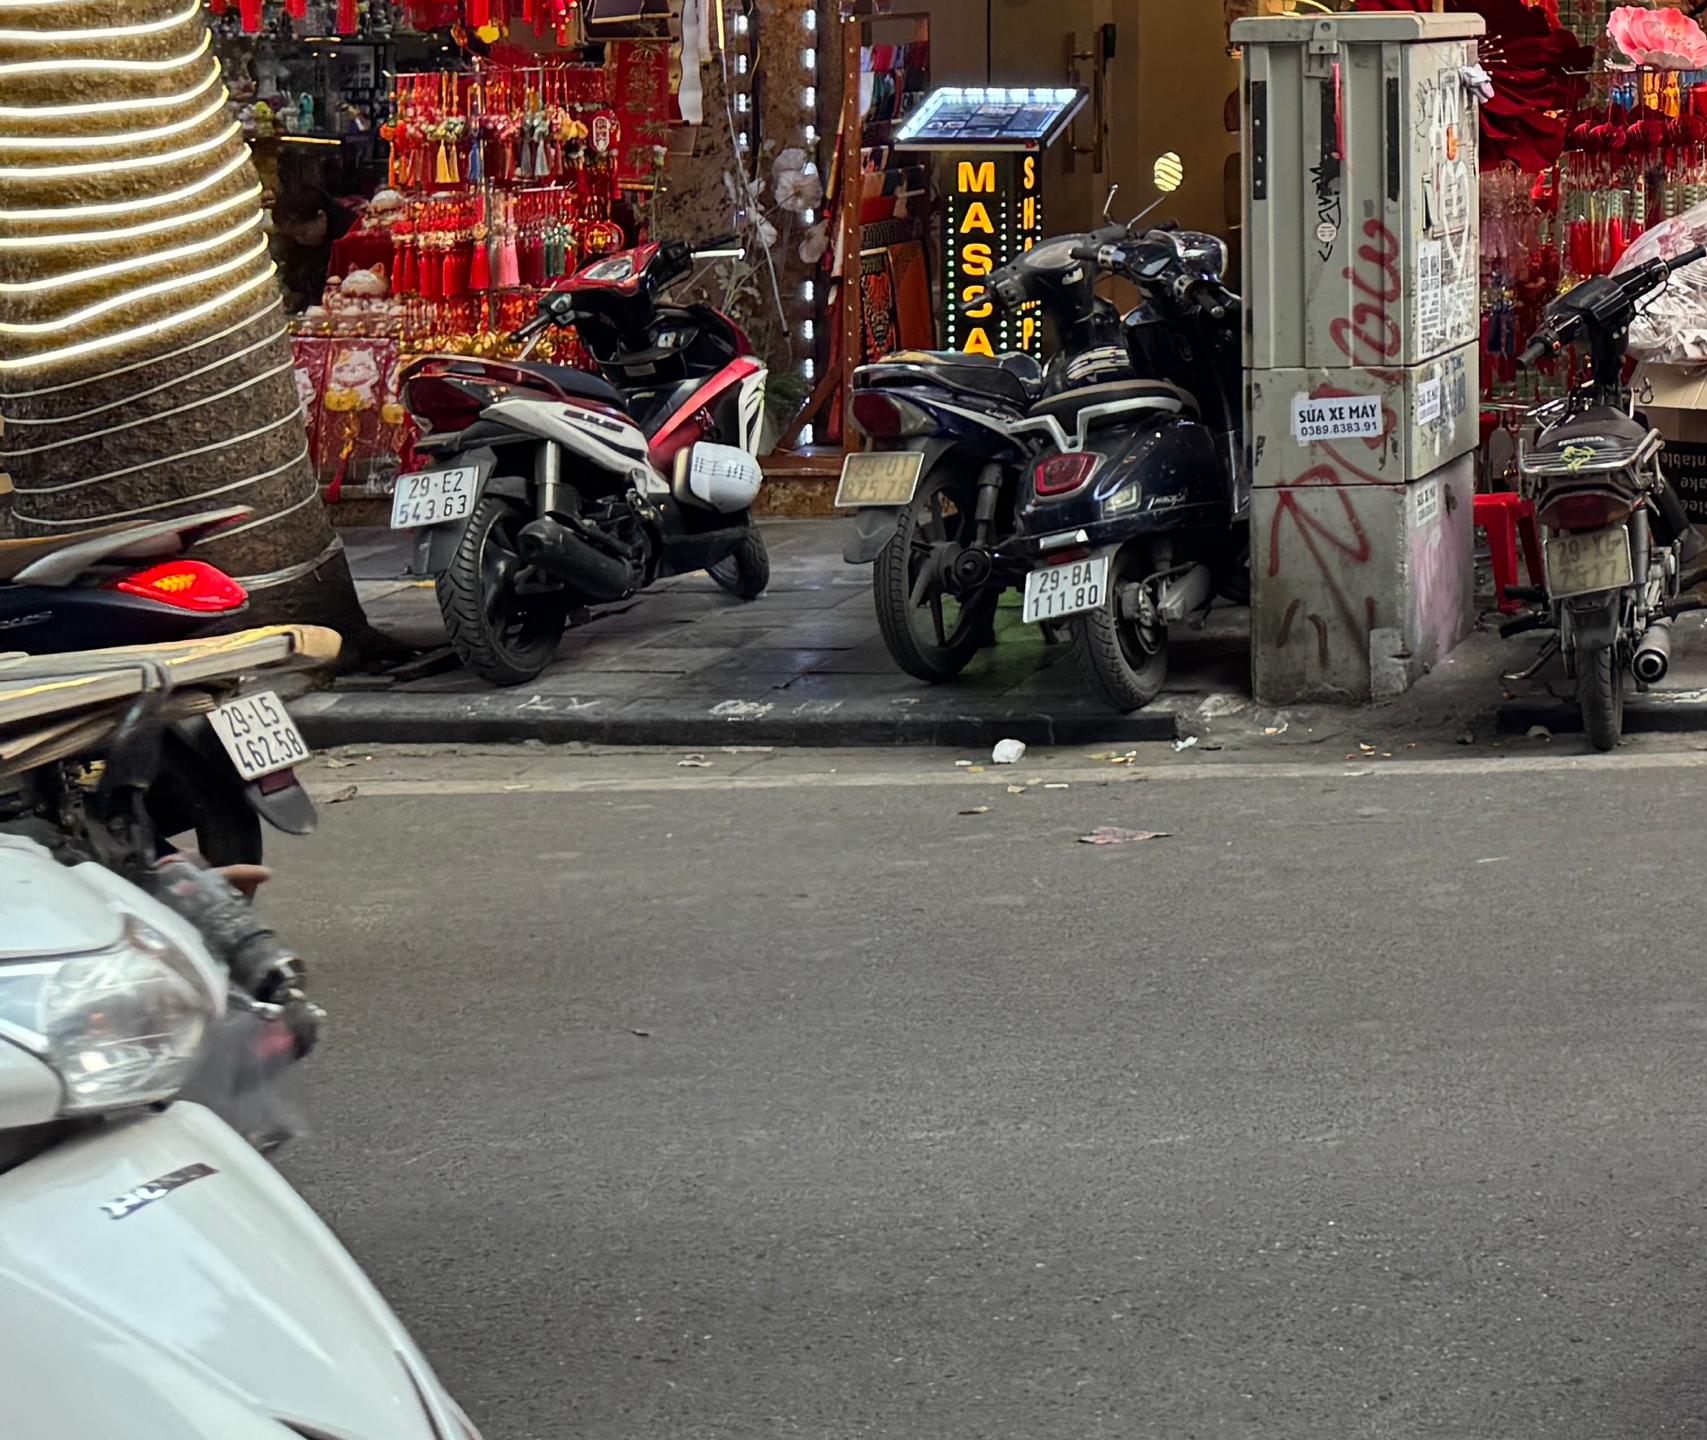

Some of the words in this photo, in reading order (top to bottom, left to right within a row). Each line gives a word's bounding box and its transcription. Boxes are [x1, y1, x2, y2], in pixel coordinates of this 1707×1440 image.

[1299, 403, 1326, 423] SỬA
[1329, 406, 1345, 420] XE
[1349, 400, 1378, 419] MÁY
[398, 494, 468, 525] 543.63
[1032, 585, 1098, 618] 111.80
[235, 727, 304, 772] 462.58
